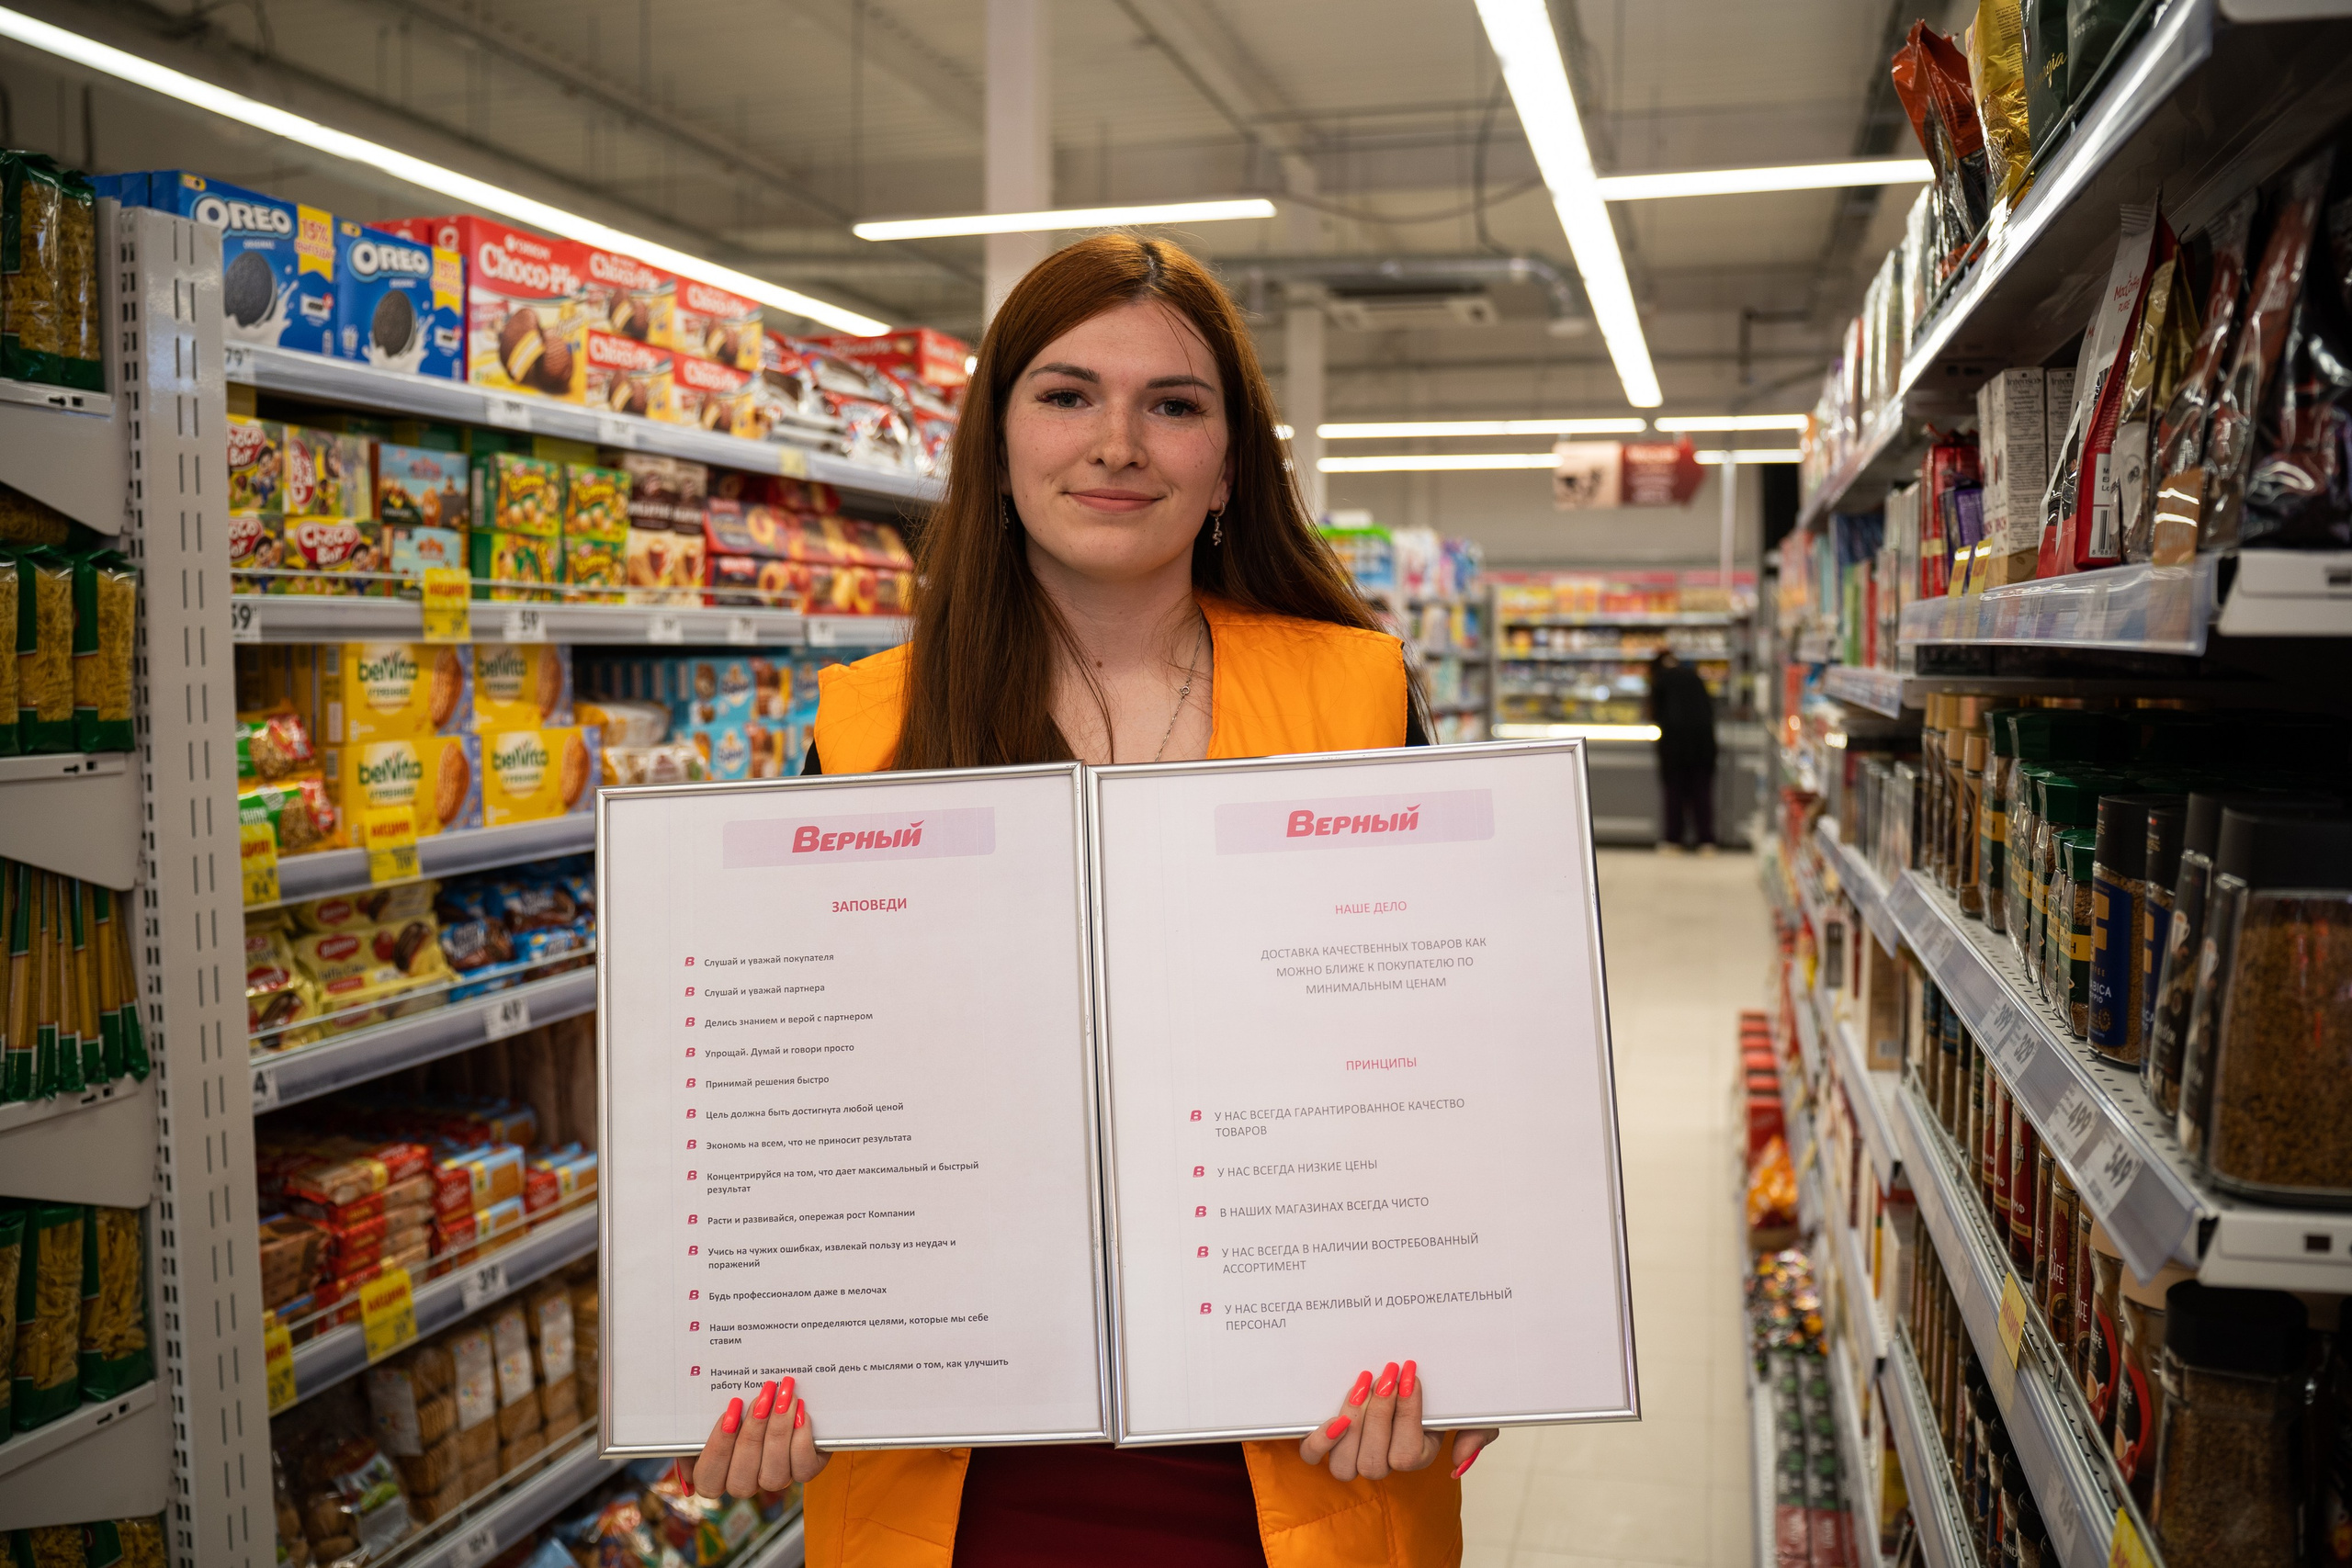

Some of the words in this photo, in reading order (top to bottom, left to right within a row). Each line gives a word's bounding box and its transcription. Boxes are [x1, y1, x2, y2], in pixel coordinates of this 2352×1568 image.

[196, 196, 292, 234] OREO
[353, 241, 430, 275] OREO
[300, 523, 356, 549] Choco
[316, 542, 347, 565] Bar
[831, 897, 907, 912] ЗАПОВЕДИ
[1335, 902, 1370, 914] НАШЕ
[1373, 900, 1407, 914] ДЕЛО
[1260, 946, 1319, 961] ДОСТАВКА
[1322, 942, 1408, 955] КАЧЕСТВЕННЫХ
[1410, 938, 1462, 950] ТОВАРОВ
[1464, 937, 1487, 947] КАК
[704, 956, 738, 967] Слушай
[747, 954, 781, 966] уважай
[783, 953, 833, 964] покупателя
[1276, 964, 1322, 976] МОЖНО
[1325, 963, 1364, 974] БЛИЖЕ
[1367, 962, 1374, 972] К
[1377, 957, 1453, 971] ПОКУПАТЕЛЮ
[1457, 956, 1474, 966] ПО
[704, 987, 738, 998] Слушай
[748, 985, 781, 996] уважай
[784, 985, 824, 994] партнера
[1306, 979, 1402, 994] МИНИМАЛЬНЫМ
[1406, 976, 1446, 990] ЦЕНАМ
[704, 1019, 737, 1028] Делись
[787, 1013, 815, 1024] верой
[823, 1013, 873, 1022] партнером
[705, 1047, 748, 1058] Упрощай.
[750, 1045, 780, 1057] Думай
[790, 1046, 821, 1055] говори
[823, 1044, 854, 1054] просто
[1346, 1056, 1417, 1070] ПРИНЦИПЫ
[706, 1077, 752, 1089] Принимай
[754, 1077, 795, 1088] решения
[797, 1076, 829, 1085] быстро
[706, 1111, 729, 1120] Цель
[729, 1110, 765, 1119] должна
[767, 1108, 789, 1116] быть
[791, 1107, 841, 1116] достигнута
[842, 1103, 873, 1112] любой
[876, 1101, 903, 1112] ценой
[1214, 1111, 1221, 1122] У
[1224, 1110, 1247, 1121] НАС
[1250, 1108, 1292, 1120] ВСЕГДА
[1294, 1101, 1405, 1117] ГАРАНТИРОВАННОЕ
[1408, 1098, 1464, 1111] КАЧЕСТВО
[2067, 1100, 2093, 1138] 499
[1215, 1125, 1267, 1137] ТОВАРОВ
[706, 1141, 746, 1149] Экономь
[818, 1136, 860, 1146] приносит
[862, 1134, 911, 1145] результата
[707, 1169, 781, 1181] Концентрируйся
[834, 1168, 856, 1177] дает
[857, 1163, 928, 1174] максимальный
[938, 1160, 978, 1171] быстрый
[1216, 1168, 1224, 1178] У
[1227, 1166, 1250, 1177] НАС
[1252, 1164, 1295, 1176] ВСЕГДА
[1297, 1161, 1341, 1173] НИЗКИЕ
[1344, 1159, 1377, 1172] ЦЕНЫ
[2104, 1143, 2132, 1188] 549
[707, 1186, 752, 1196] результат
[1219, 1207, 1227, 1217] В
[1229, 1205, 1272, 1216] НАШИХ
[1274, 1201, 1343, 1214] МАГАЗИНАХ
[1346, 1199, 1388, 1211] ВСЕГДА
[1391, 1196, 1429, 1208] ЧИСТО
[707, 1216, 731, 1224] Расти
[742, 1213, 797, 1224] развивайся,
[798, 1213, 843, 1222] опережая
[846, 1212, 865, 1221] рост
[868, 1210, 915, 1218] Компании
[707, 1247, 734, 1256] Учись
[749, 1247, 778, 1258] чужих
[779, 1244, 822, 1253] ошибках,
[824, 1241, 866, 1251] извлекай
[869, 1242, 900, 1250] пользу
[915, 1240, 947, 1248] неудач
[1221, 1247, 1228, 1258] У
[1231, 1247, 1254, 1257] НАС
[1257, 1244, 1299, 1257] ВСЕГДА
[1302, 1244, 1309, 1253] В
[1312, 1240, 1368, 1253] НАЛИЧИИ
[1371, 1232, 1478, 1249] ВОСТРЕБОВАННЫЙ
[707, 1259, 761, 1271] поражений
[1222, 1259, 1306, 1273] АССОРТИМЕНТ
[708, 1292, 730, 1302] Будь
[732, 1290, 811, 1301] профессионалом
[813, 1289, 838, 1298] даже
[1224, 1304, 1231, 1314] У
[1235, 1303, 1257, 1314] НАС
[1261, 1301, 1303, 1313] ВСЕГДА
[1306, 1294, 1371, 1310] ВЕЖЛИВЫЙ
[1374, 1296, 1383, 1306] И
[1385, 1286, 1511, 1308] ДОБРОЖЕЛАТЕЛЬНЫЙ
[737, 1322, 798, 1330] возможности
[800, 1319, 866, 1329] определяются
[868, 1318, 907, 1327] целями,
[909, 1316, 948, 1325] которые
[967, 1313, 989, 1322] себе
[1226, 1317, 1285, 1330] ПЕРСОНАЛ
[710, 1366, 751, 1377] Начинай
[760, 1364, 813, 1376] заканчивай
[814, 1363, 836, 1372] свой
[838, 1365, 861, 1373] день
[869, 1362, 913, 1371] мыслями
[964, 1359, 1008, 1369] улучшить
[710, 1380, 741, 1391] работу
